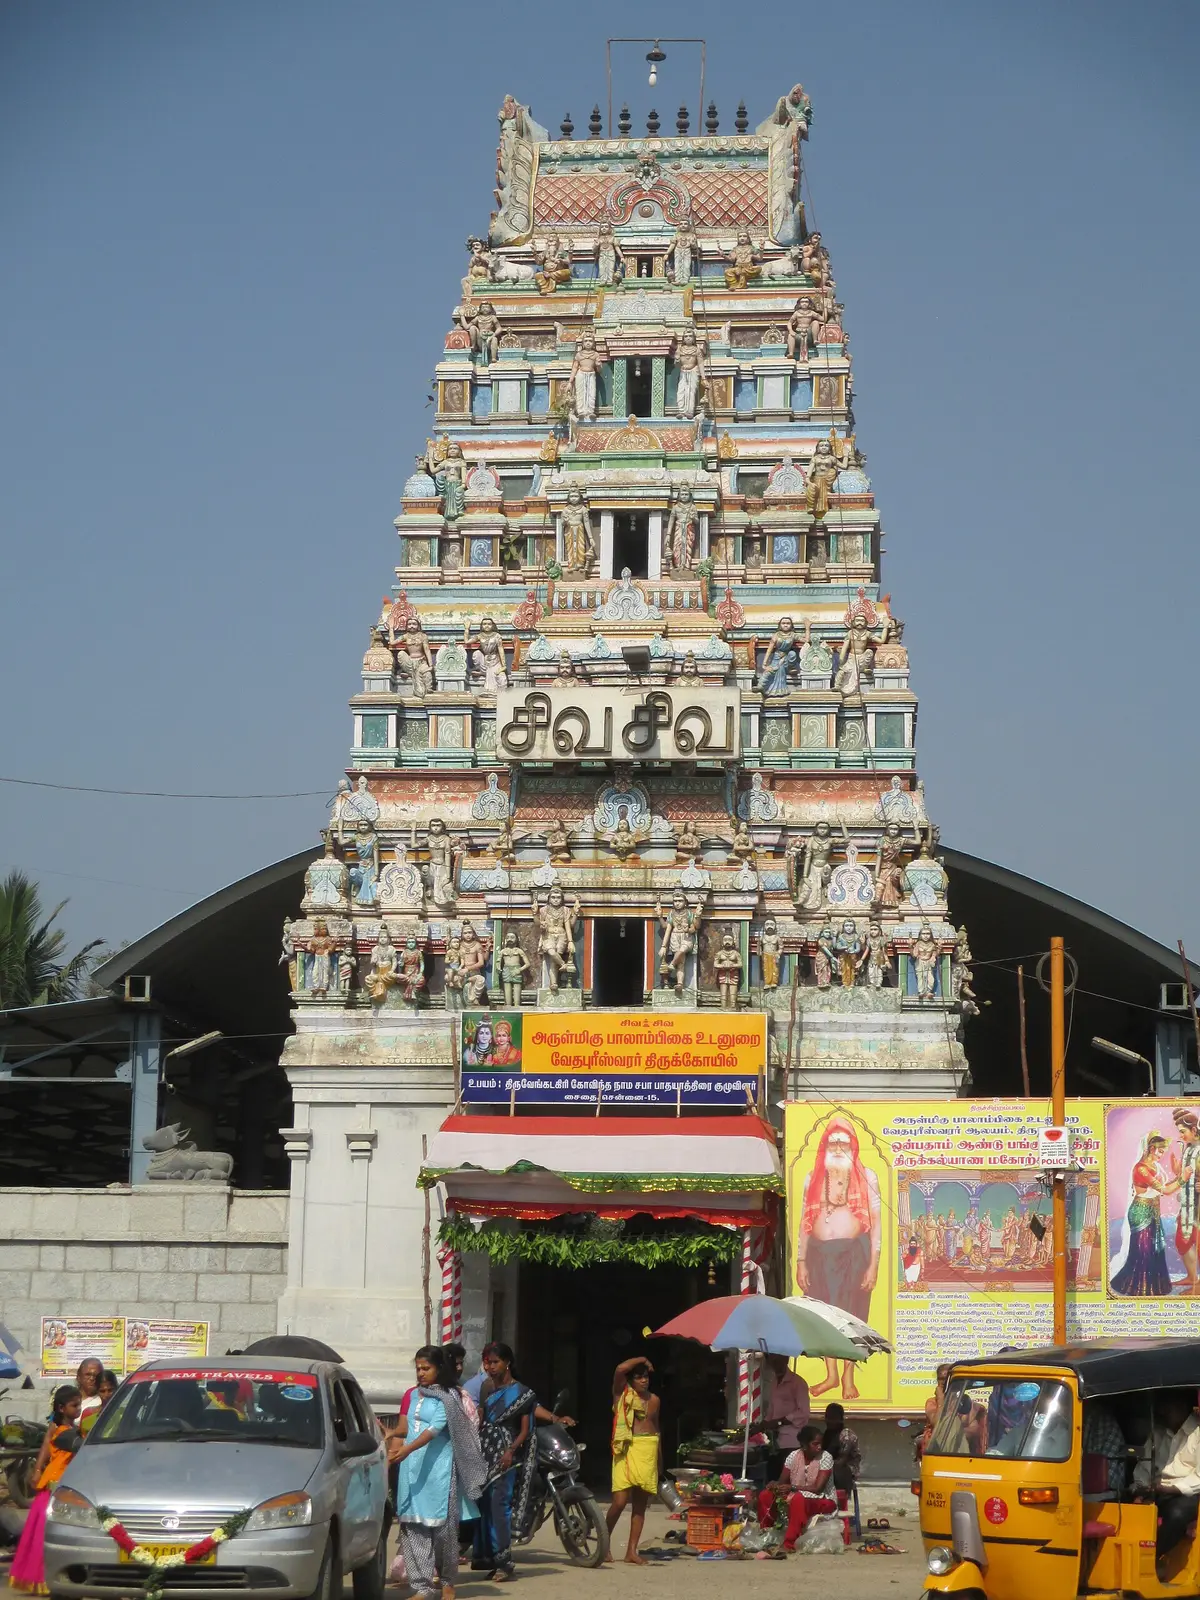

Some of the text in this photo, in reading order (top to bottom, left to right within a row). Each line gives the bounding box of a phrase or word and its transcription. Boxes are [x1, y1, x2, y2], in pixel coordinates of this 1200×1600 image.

[500, 690, 735, 754] சிவ சிவ
[620, 1019, 674, 1027] சிவ சிவ
[531, 1030, 761, 1050] அருள்மிகு பாலாம்பிகை உடனுறை
[551, 1051, 738, 1071] வேதபுரீஸ்வரர் திருக்கோயில்
[505, 1078, 569, 1091] திருவேங்கடகிரி
[571, 1078, 612, 1091] கோவிந்த
[614, 1080, 633, 1091] நாம
[635, 1081, 652, 1090] சபா
[654, 1080, 712, 1092] பாதயாத்திரை
[714, 1079, 757, 1093] குழுவினர்
[893, 1115, 949, 1125] அருள்மிகு
[952, 1114, 1022, 1124] பாலாம்பிகை
[883, 1126, 961, 1136] வேதபுரீஸ்வரர்
[891, 1138, 954, 1152] ஒன்பதாம்
[957, 1138, 1004, 1151] ஆண்டு
[893, 1153, 984, 1167] திருக்கல்யாண
[202, 1371, 273, 1381] TRAVELS
